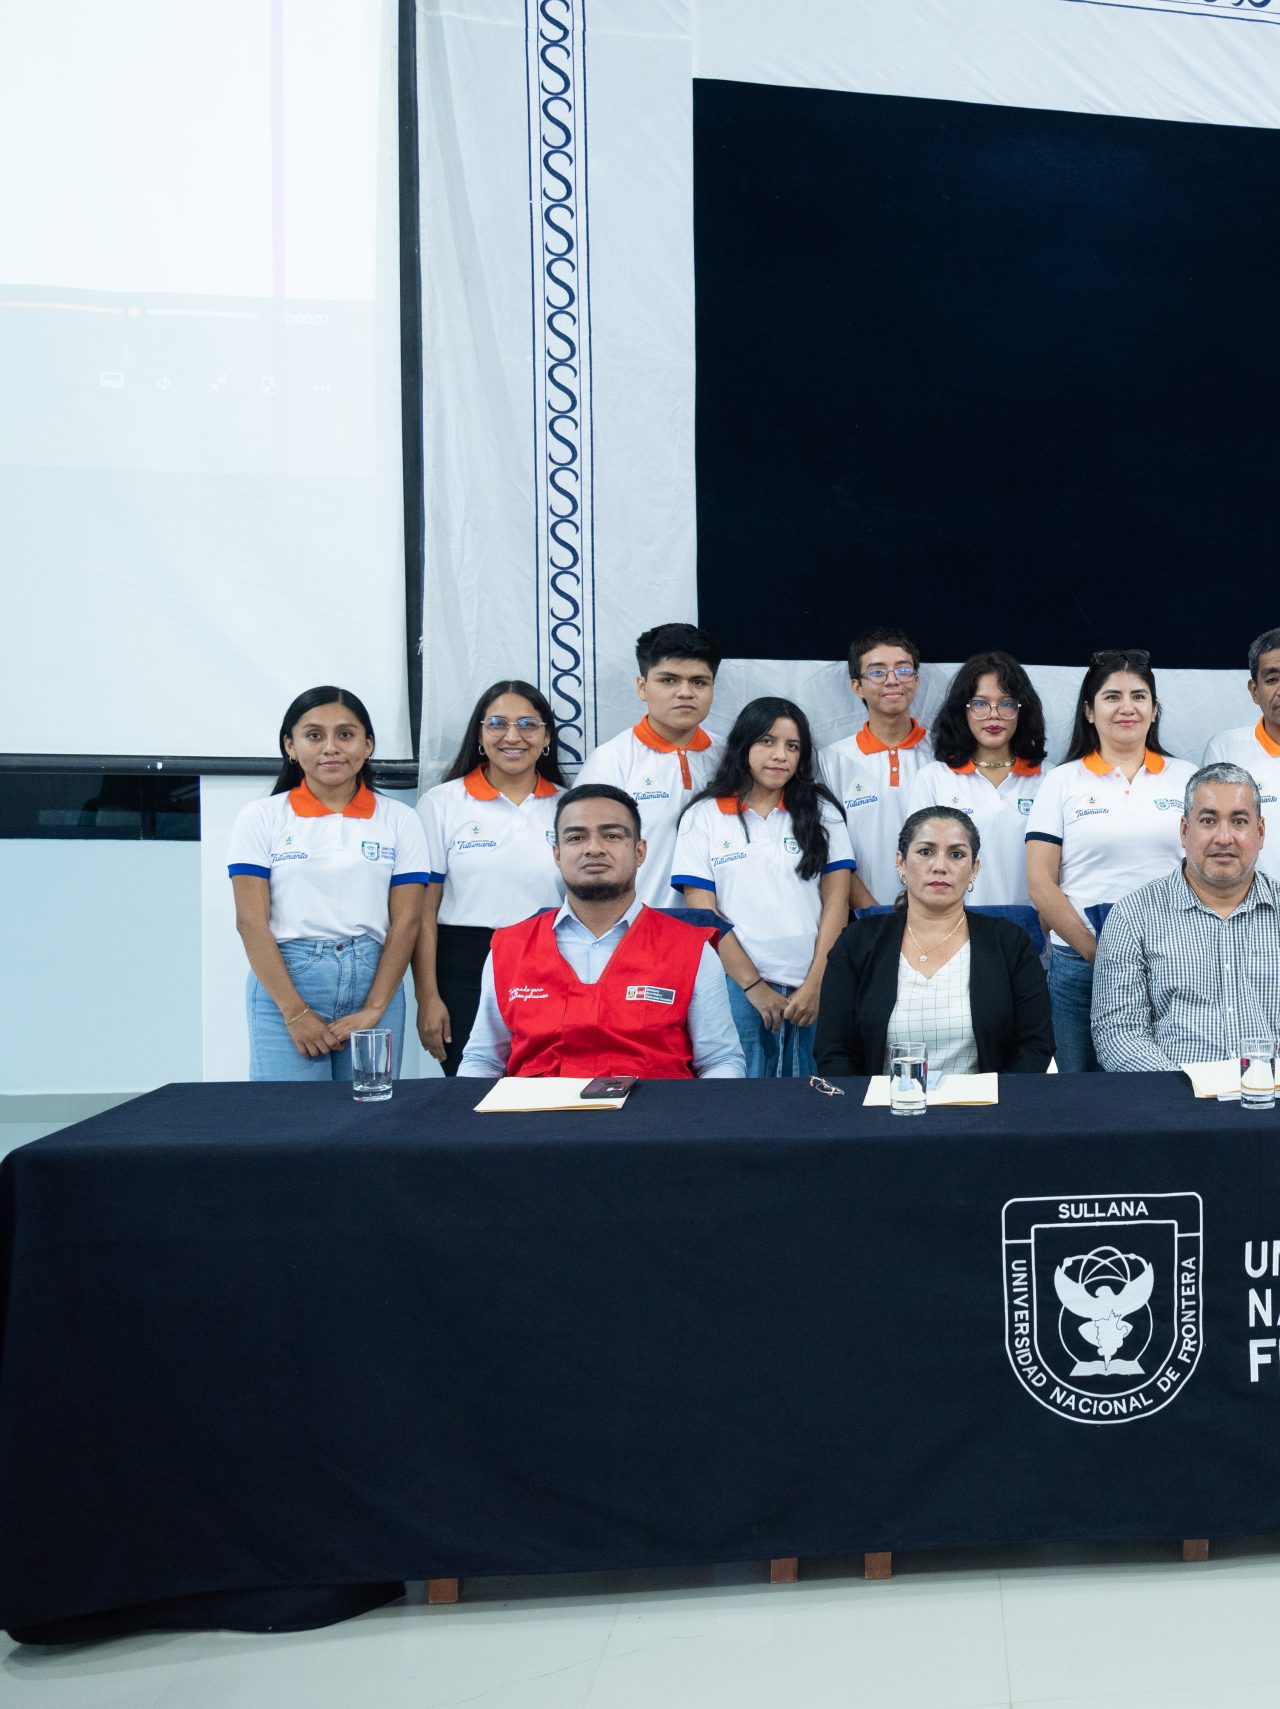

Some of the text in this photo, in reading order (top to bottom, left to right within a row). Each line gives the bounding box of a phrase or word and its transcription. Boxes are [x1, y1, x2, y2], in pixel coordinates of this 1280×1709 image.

[1058, 1200, 1149, 1219] SULLANA
[1012, 1256, 1197, 1415] UNIVERSIDAD NACIONAL DE FRONTERA
